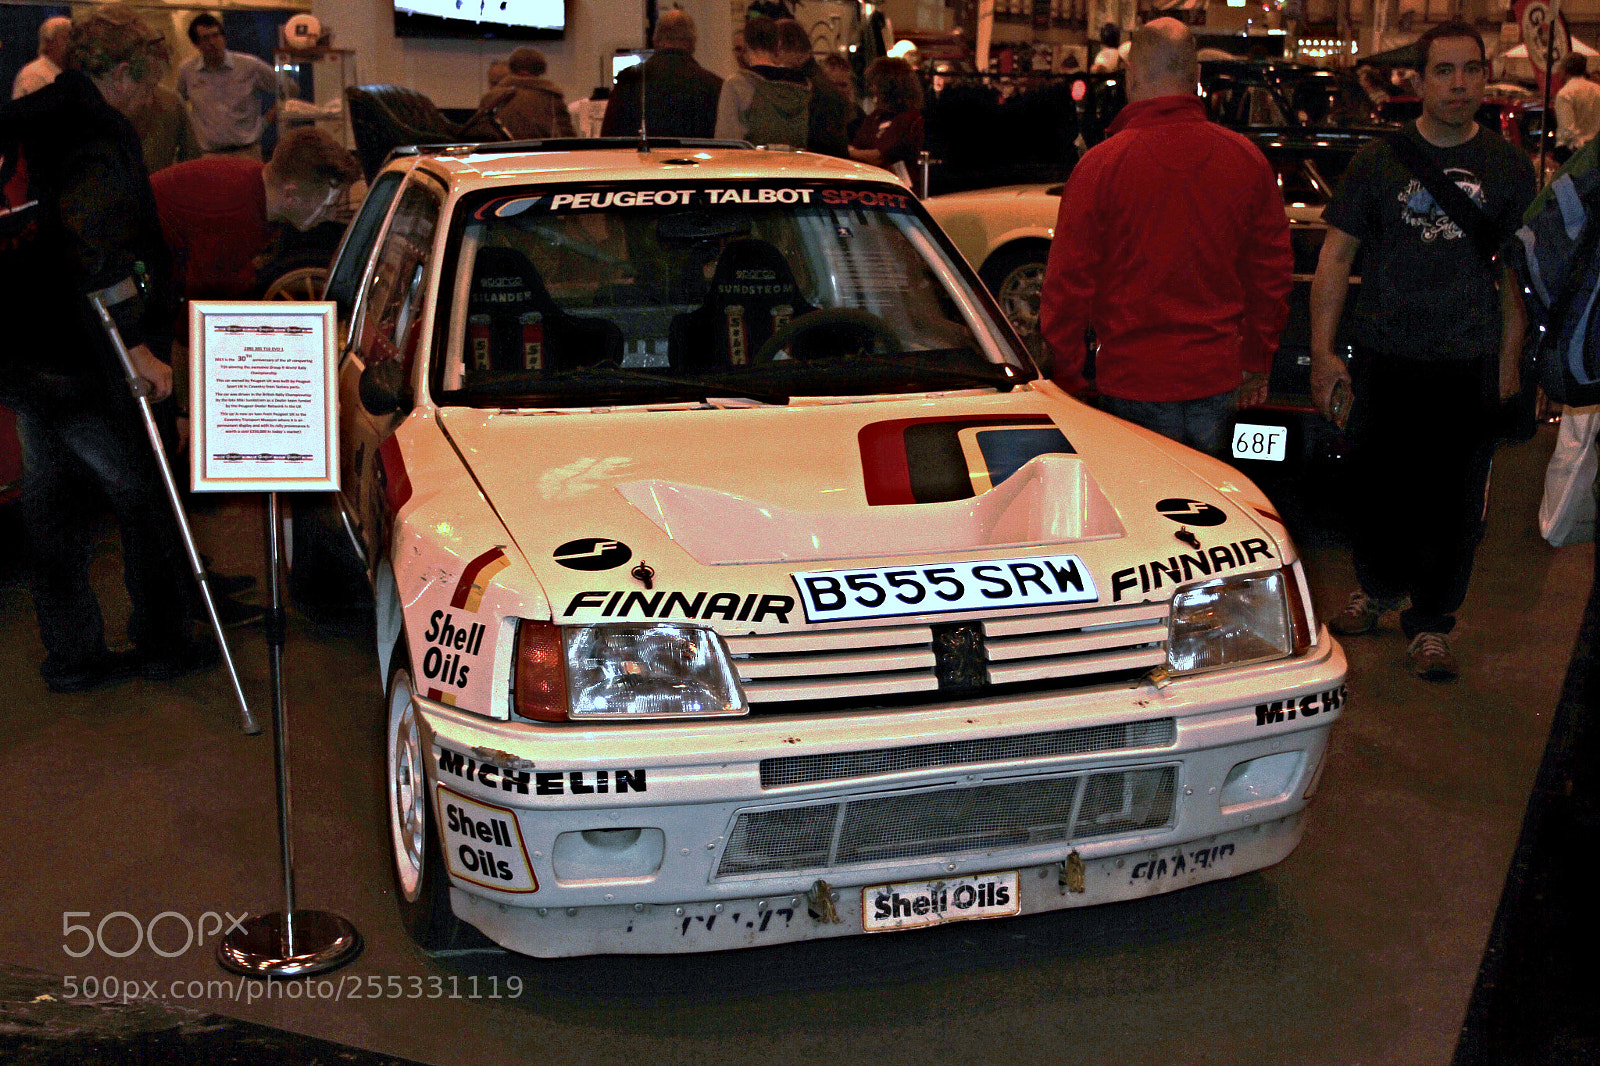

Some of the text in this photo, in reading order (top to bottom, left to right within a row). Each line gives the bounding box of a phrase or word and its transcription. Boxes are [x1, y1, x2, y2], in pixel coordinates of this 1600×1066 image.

[550, 188, 910, 210] PEUGEOT TALBOT SPORT
[1236, 432, 1280, 454] 68F
[803, 559, 1085, 612] B555 SRW
[1111, 538, 1275, 602] FINNAIR
[563, 591, 795, 624] FINNAIR
[424, 609, 486, 656] Shell
[423, 646, 470, 689] Oils
[440, 748, 647, 796] MICHELIN
[446, 803, 512, 847] Shell
[458, 844, 514, 881] Oils
[874, 881, 1010, 921] Shell Oils
